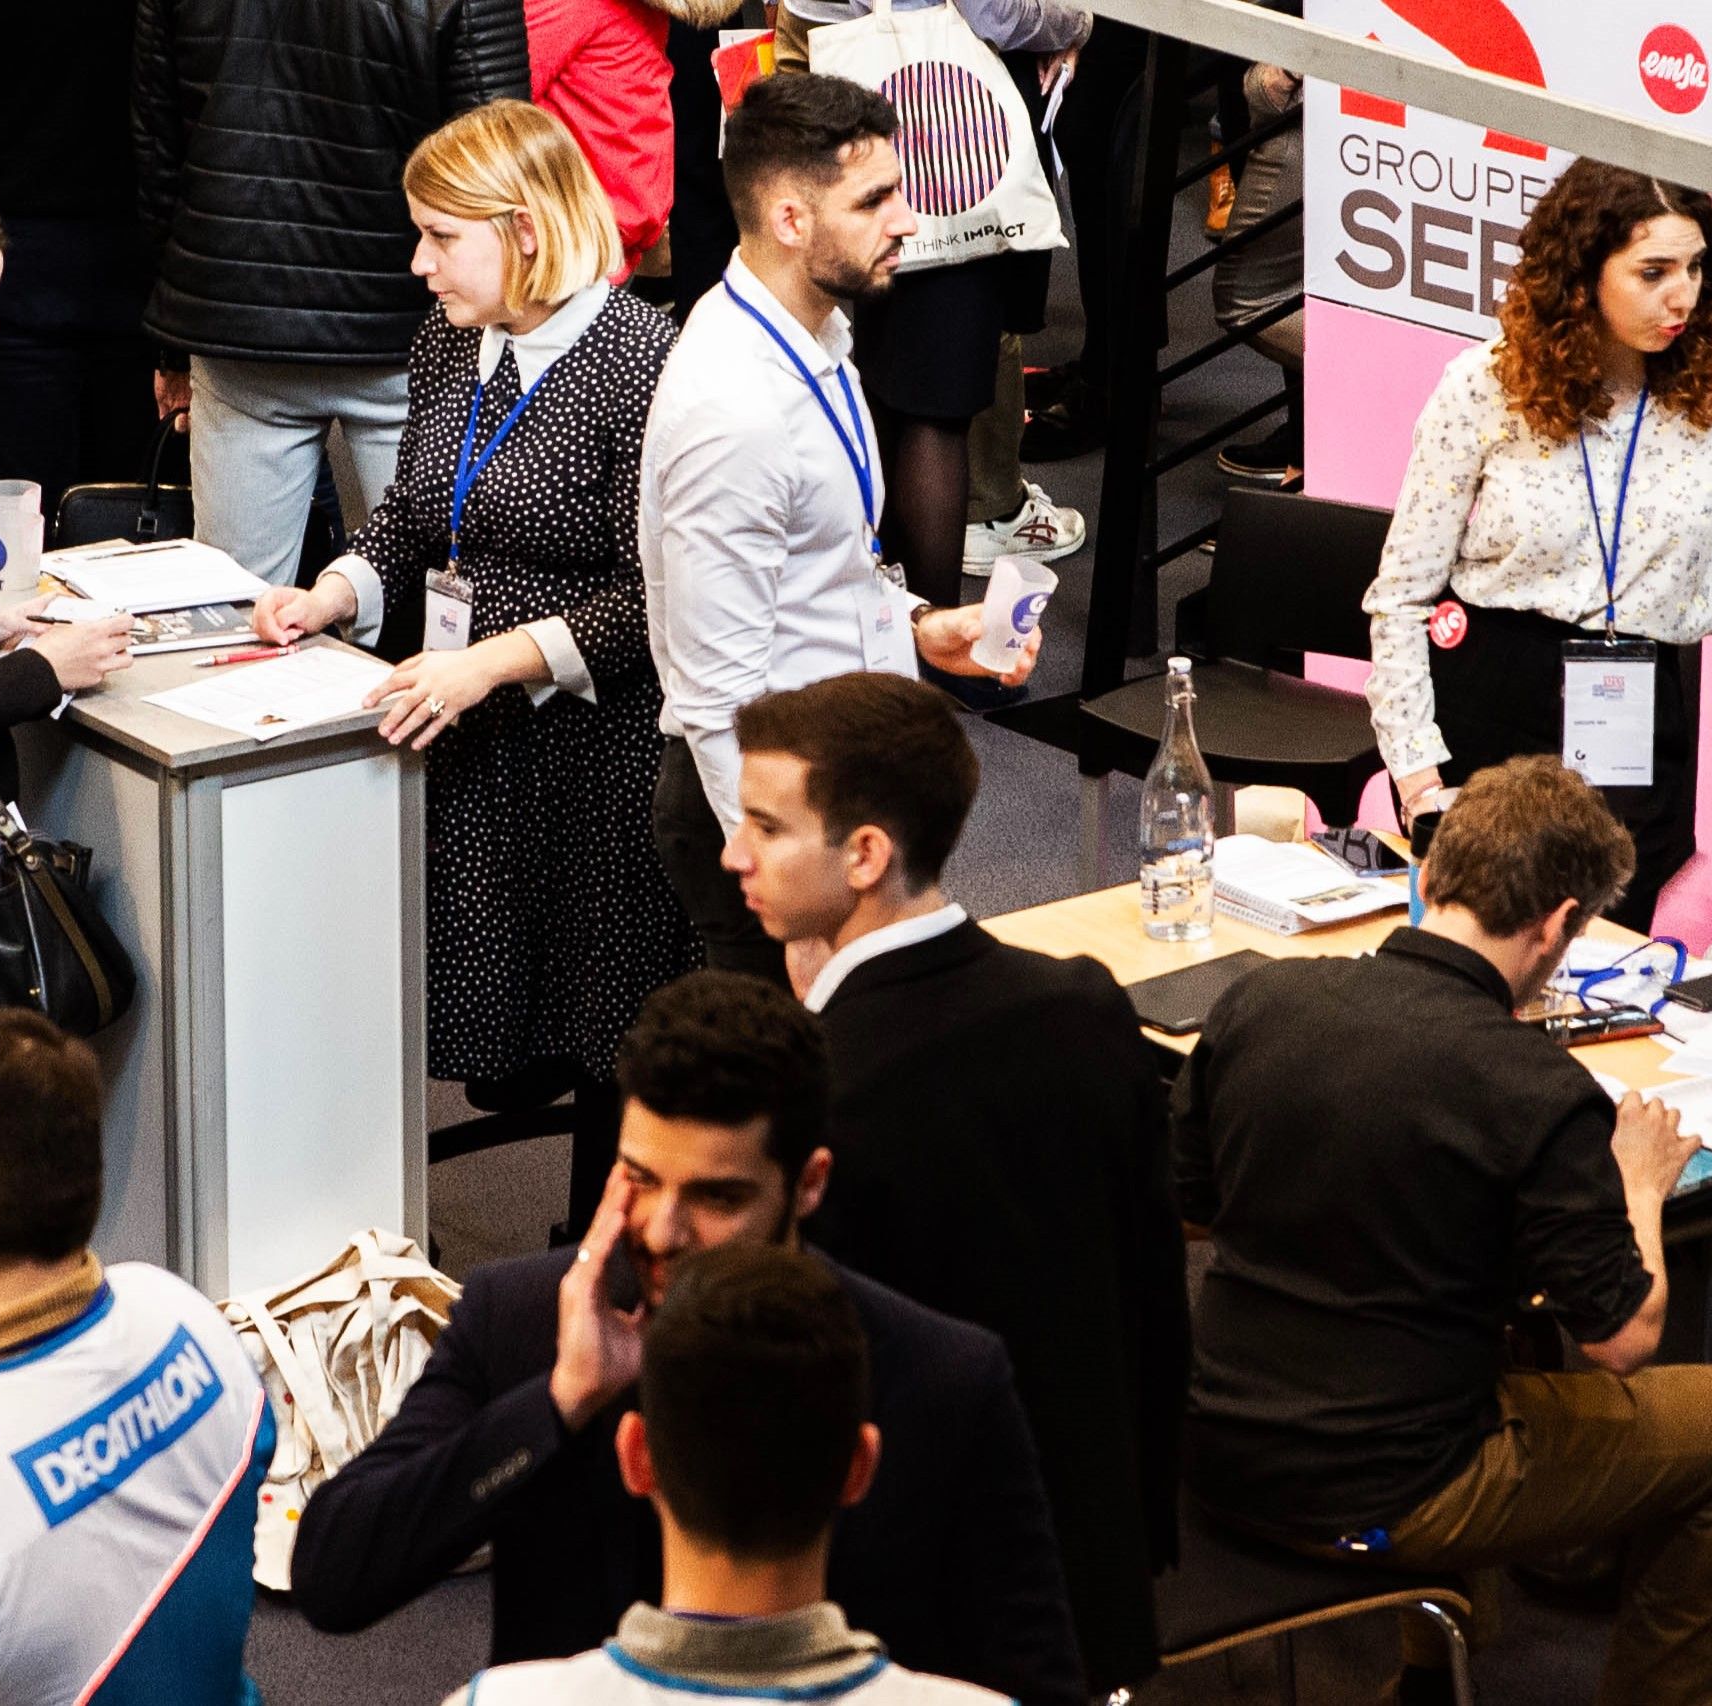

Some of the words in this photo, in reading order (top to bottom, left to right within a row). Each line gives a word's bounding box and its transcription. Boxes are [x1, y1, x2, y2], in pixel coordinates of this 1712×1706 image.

[1340, 133, 1547, 216] GROUPE
[912, 233, 961, 255] THINK
[964, 222, 1026, 243] IMPACT
[32, 1339, 215, 1506] DECATHLON
